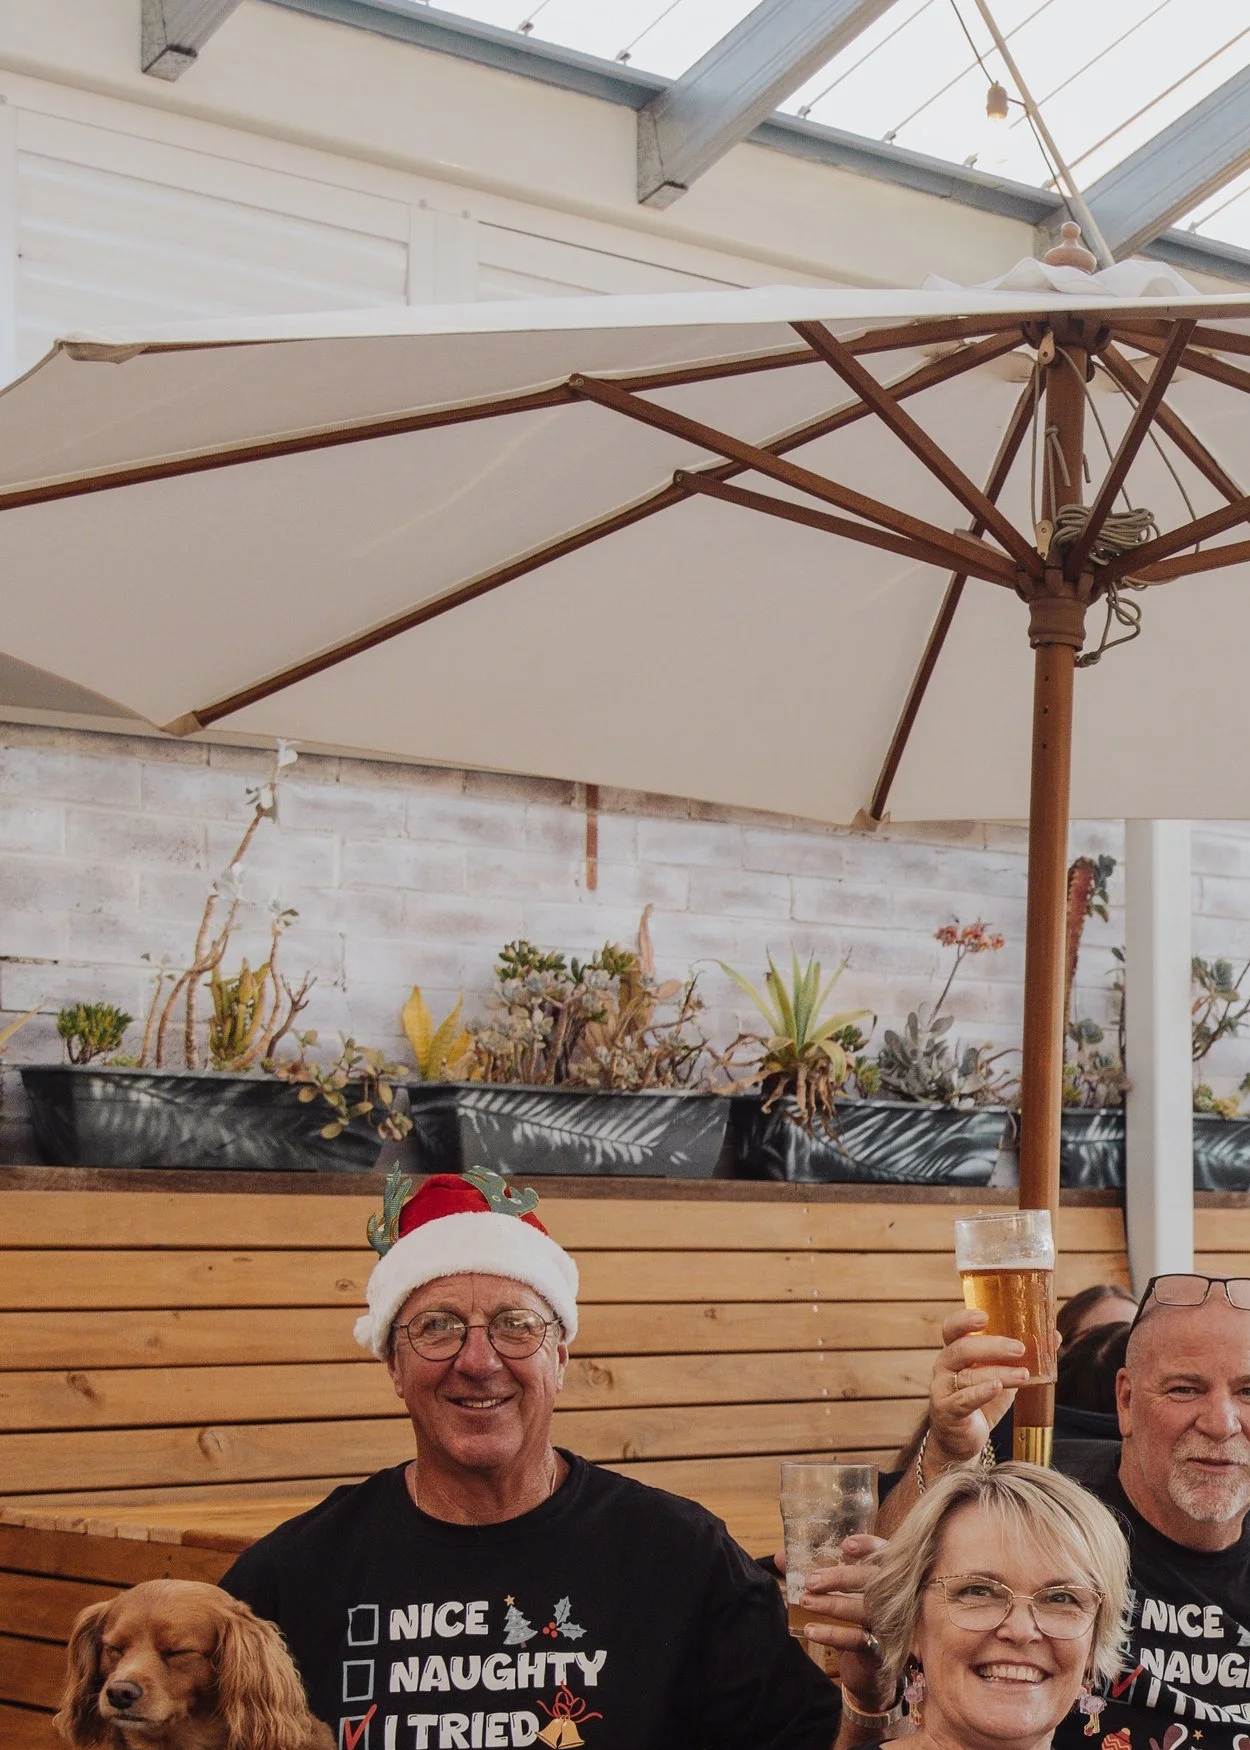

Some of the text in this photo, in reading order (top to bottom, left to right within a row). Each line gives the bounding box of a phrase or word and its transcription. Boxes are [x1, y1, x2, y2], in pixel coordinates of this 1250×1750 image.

[389, 1600, 489, 1641] NICE
[1141, 1598, 1224, 1638] NICE
[389, 1650, 607, 1693] NAUGHTY
[1146, 1677, 1161, 1708] I
[384, 1711, 539, 1750] I TRIED
